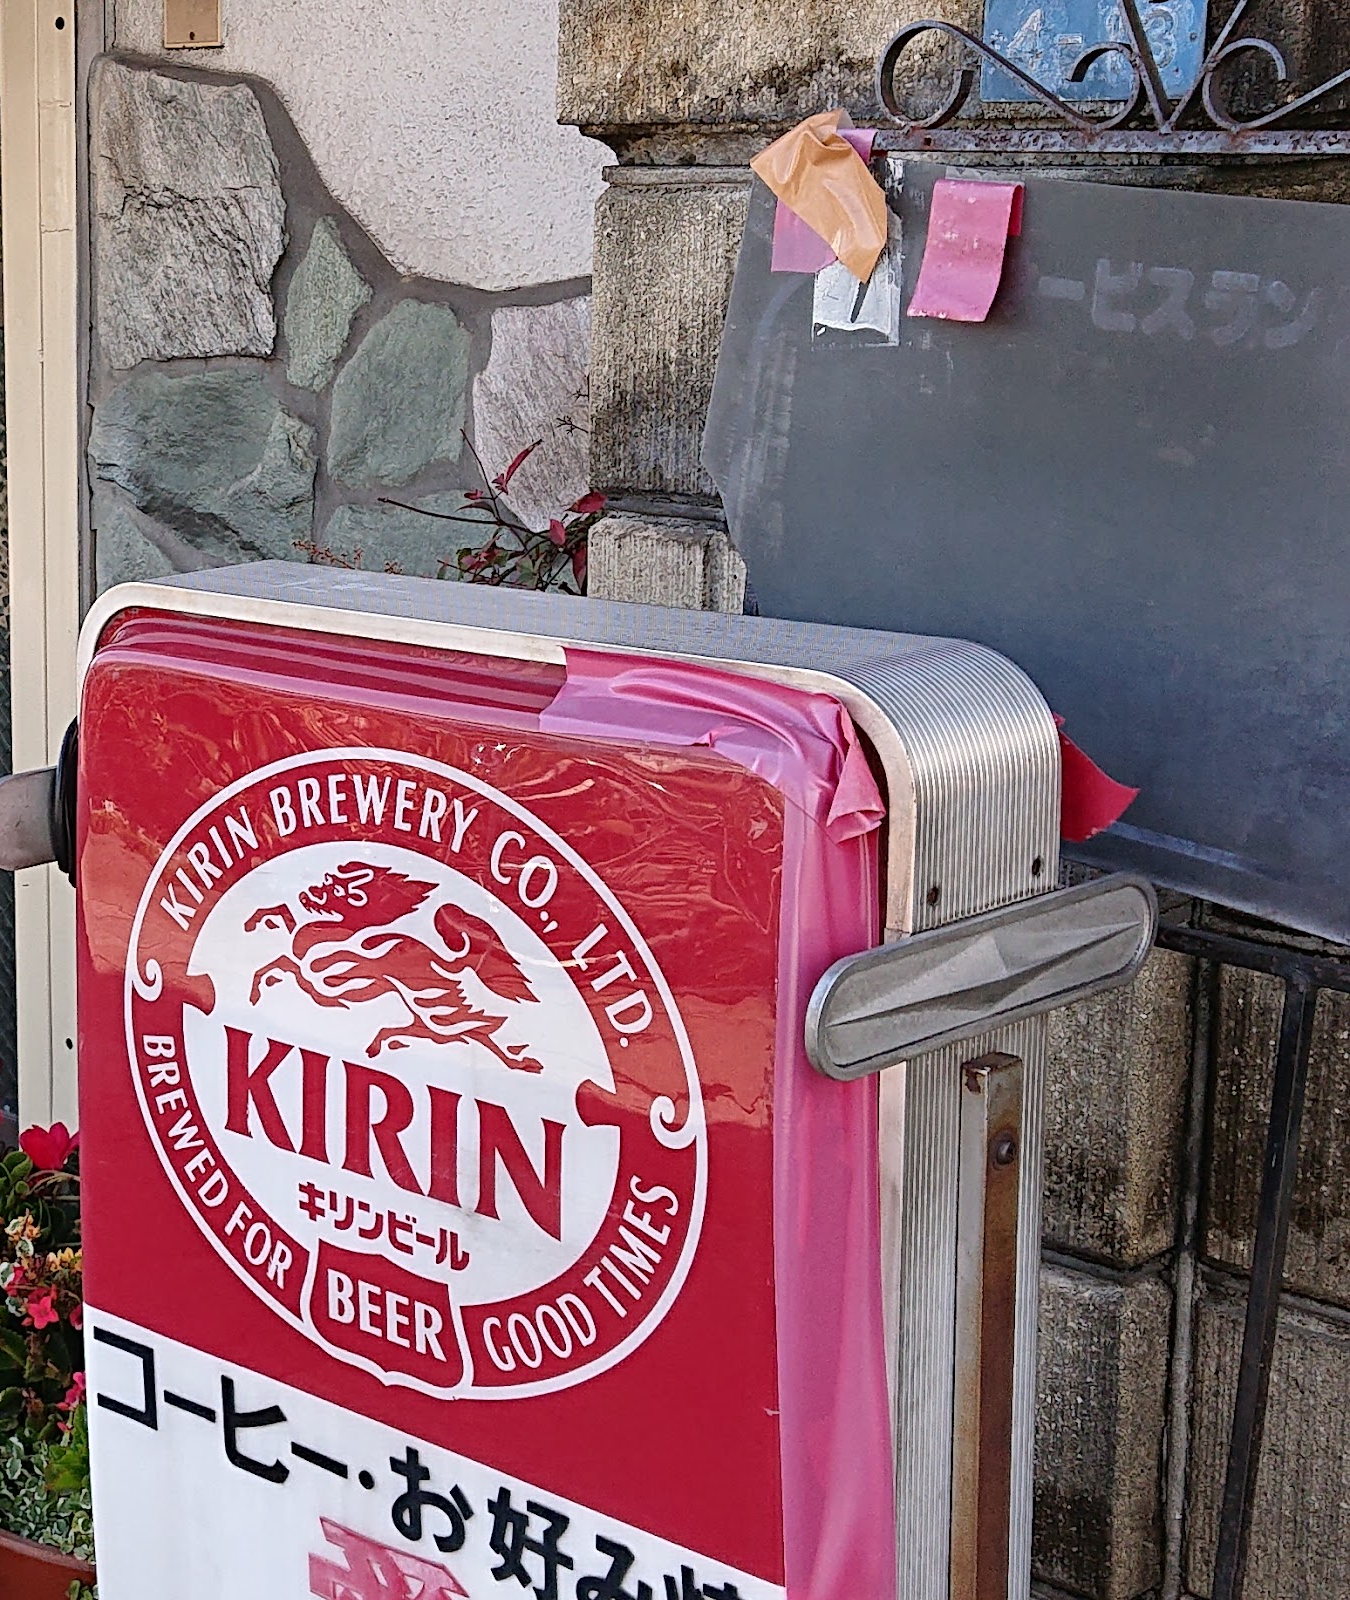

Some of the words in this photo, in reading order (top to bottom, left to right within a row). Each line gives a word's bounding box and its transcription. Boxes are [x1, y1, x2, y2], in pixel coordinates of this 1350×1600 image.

[160, 815, 257, 933] KIRIN
[271, 774, 478, 857] BREWERY
[490, 828, 561, 936] CO.,
[571, 921, 654, 1050] LTD.
[140, 1033, 227, 1208] BREWED
[223, 1204, 291, 1292] FOR
[223, 1025, 567, 1243] KIRIN
[298, 1180, 471, 1273] キリンビール
[326, 1272, 448, 1364] BEER
[482, 1293, 599, 1371] GOOD
[582, 1174, 680, 1319] TIMES
